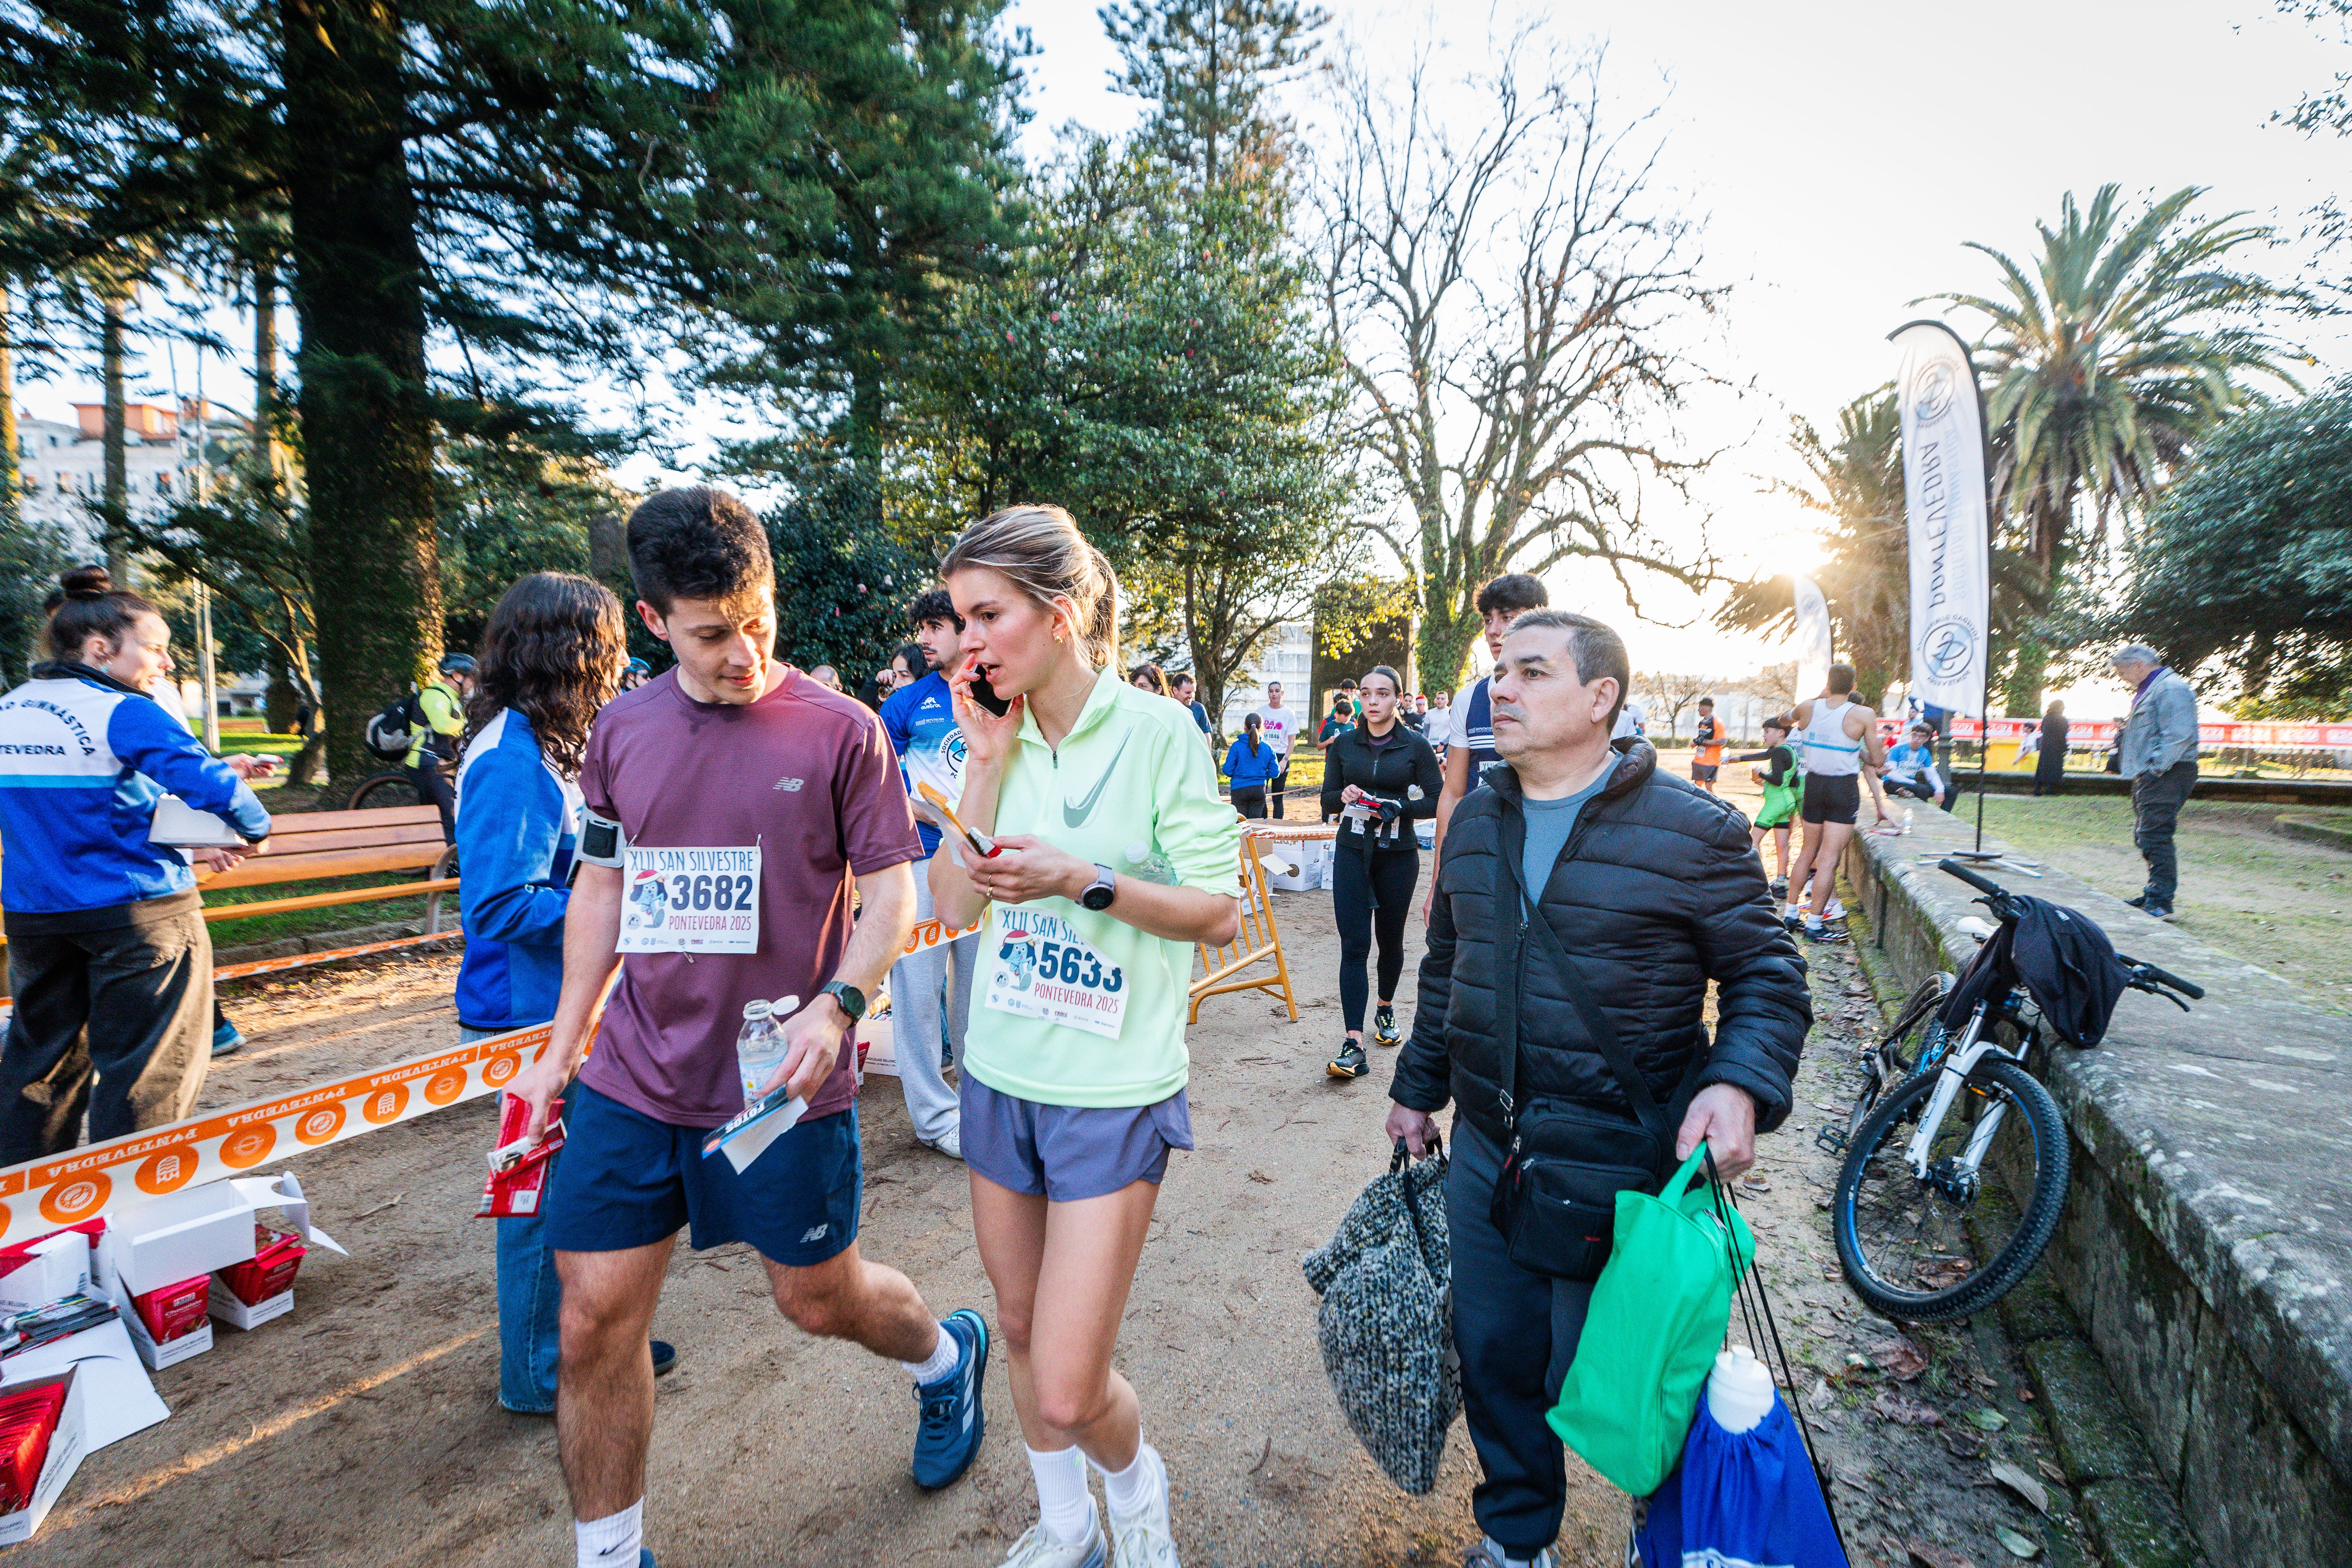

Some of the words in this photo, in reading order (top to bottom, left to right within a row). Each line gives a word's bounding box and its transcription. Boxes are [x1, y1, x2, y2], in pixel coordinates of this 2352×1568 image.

[940, 730, 962, 754] SOCIEDAD
[631, 851, 654, 871] XLII
[659, 851, 685, 871] SAN
[690, 851, 753, 871] SILVESTRE
[671, 875, 753, 911] 3682
[669, 916, 727, 930] PONTEVEDRA
[730, 916, 751, 931] 2025
[1002, 910, 1028, 931] XLII
[1031, 913, 1057, 938] SAN
[1034, 983, 1093, 1008] PONTEVEDRA
[1096, 995, 1119, 1014] 2025
[725, 1102, 764, 1134] FOTOS
